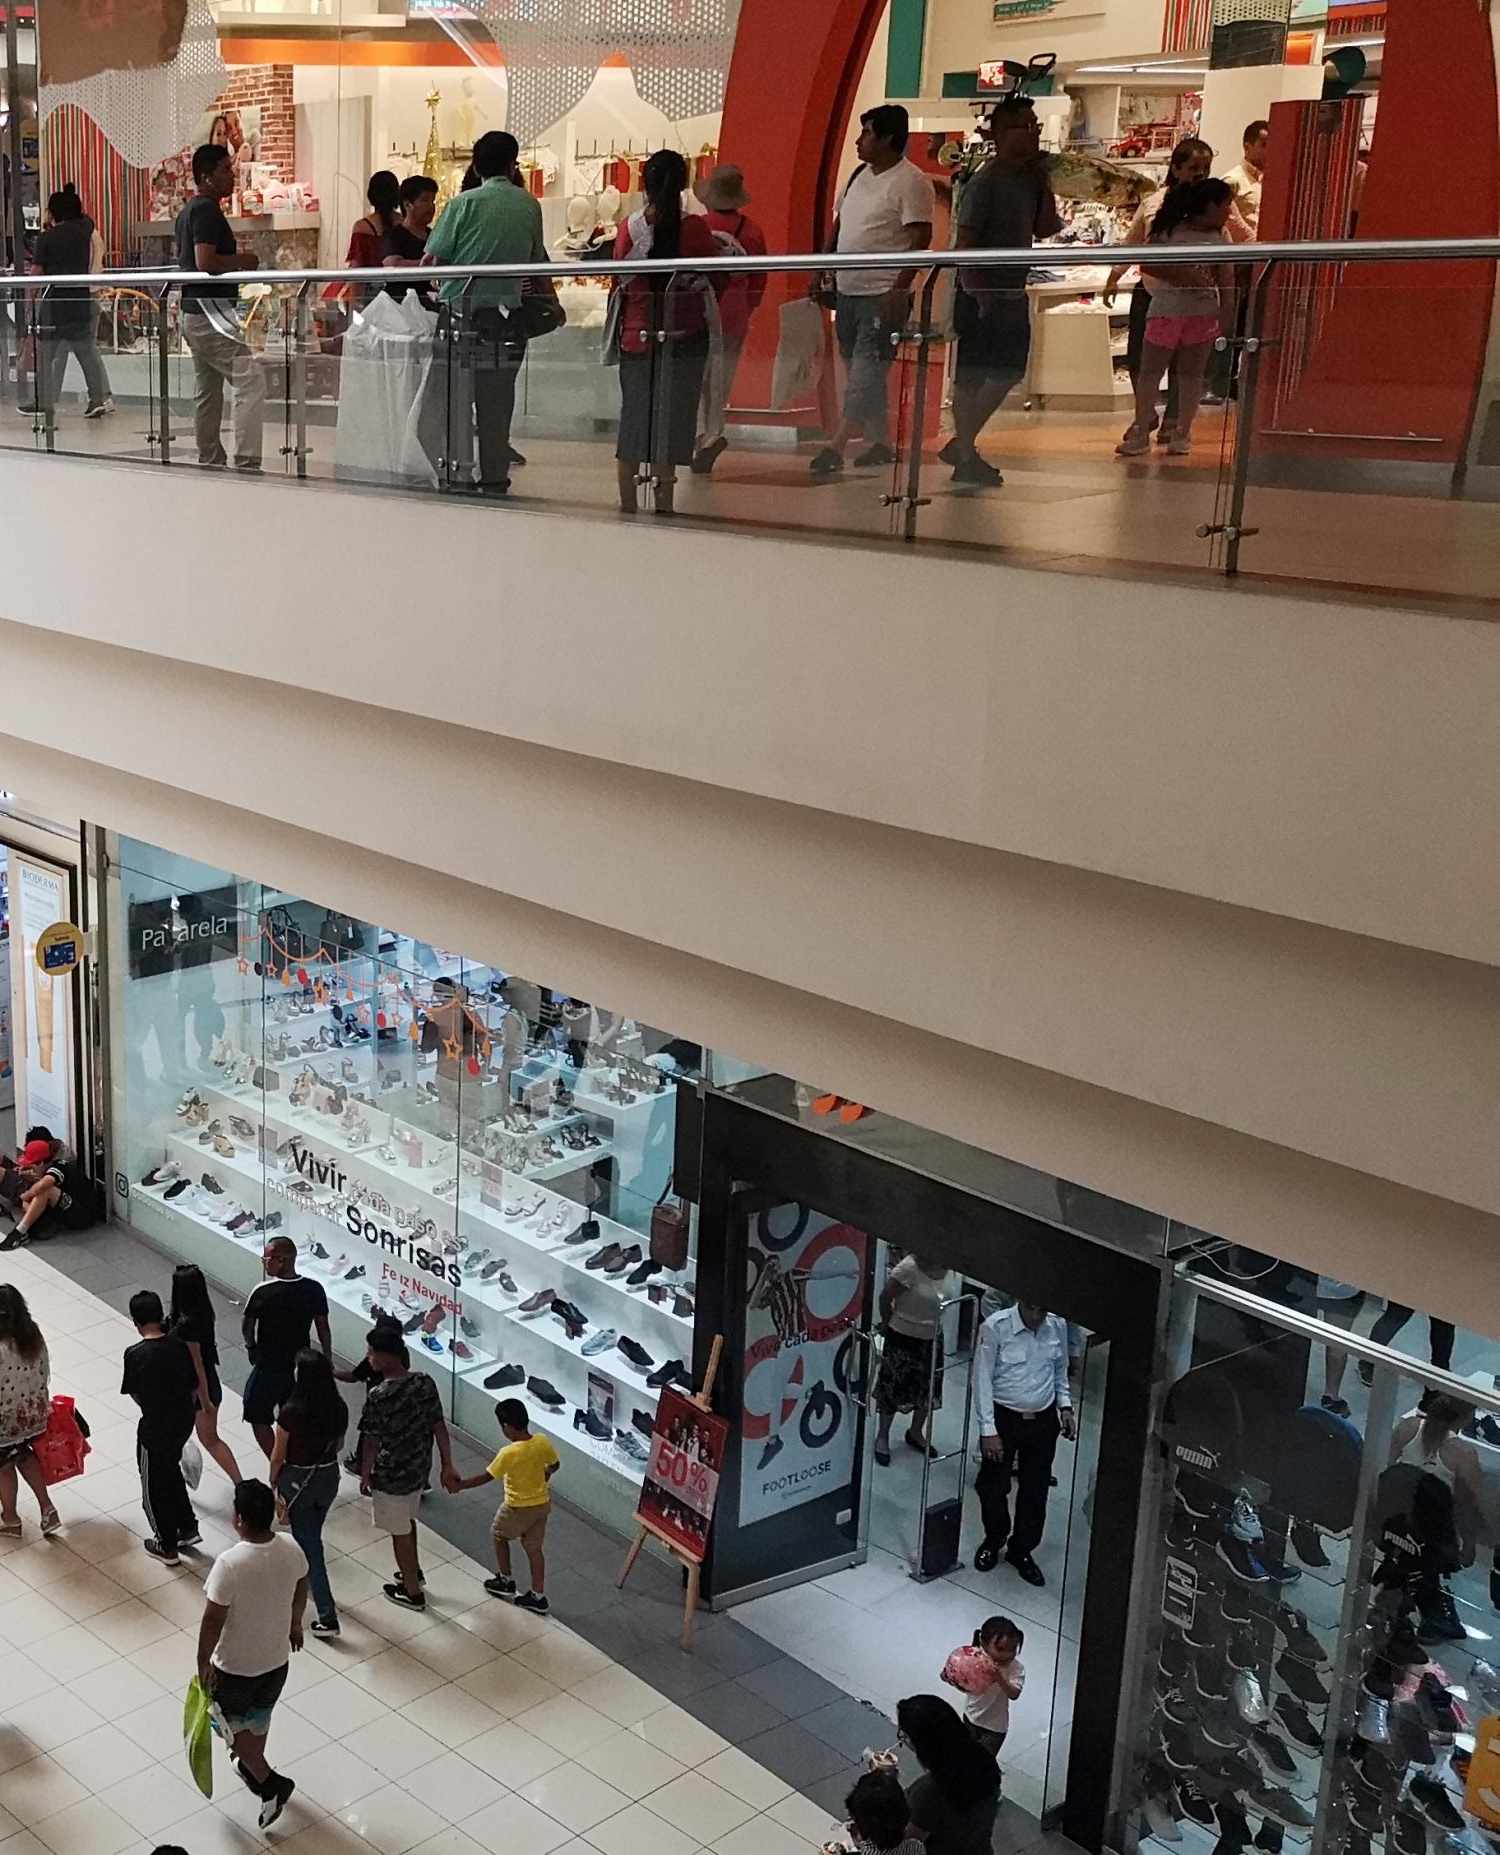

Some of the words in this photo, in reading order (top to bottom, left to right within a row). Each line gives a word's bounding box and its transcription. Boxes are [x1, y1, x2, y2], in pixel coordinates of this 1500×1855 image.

[22, 871, 59, 890] BIODERMA
[142, 915, 227, 950] Paarela
[290, 1142, 347, 1193] Vivir
[346, 1204, 462, 1287] Sonrisas
[382, 1262, 409, 1285] Feiz
[412, 1280, 463, 1316] Navidad
[656, 1441, 707, 1492] 50%
[762, 1459, 832, 1495] FOOTLOOSE
